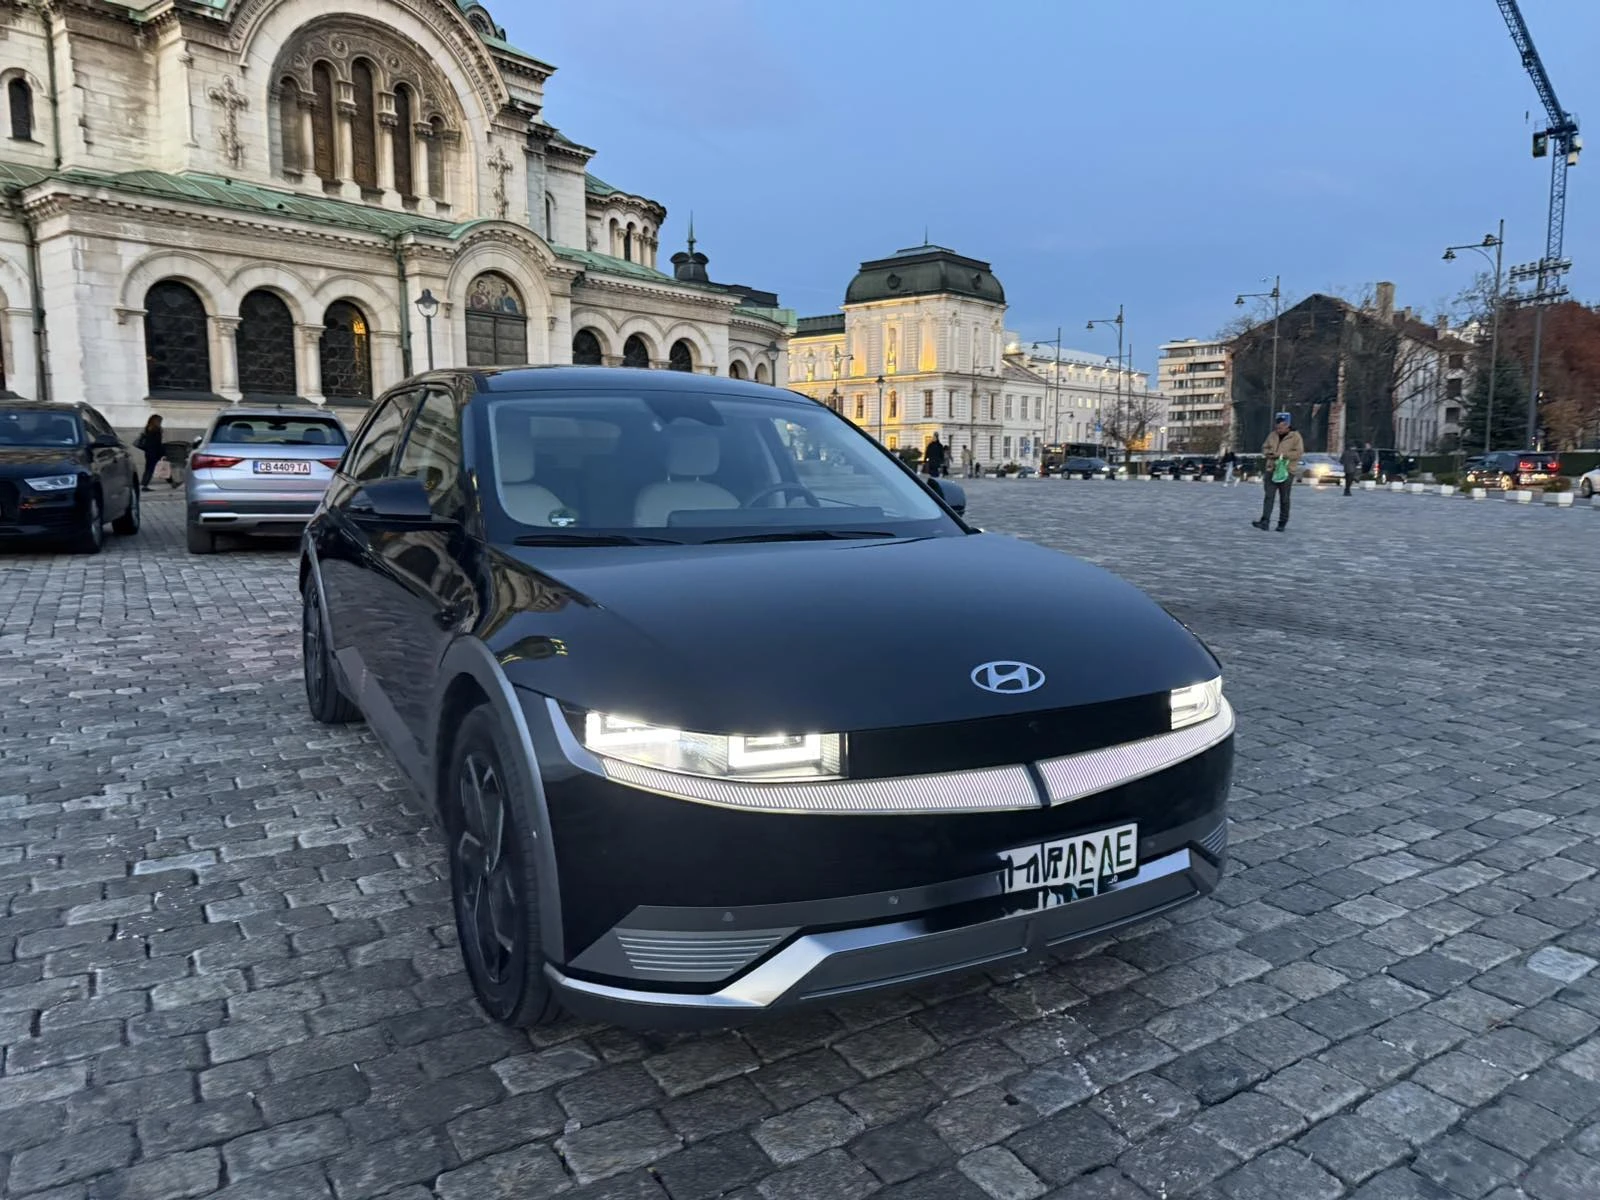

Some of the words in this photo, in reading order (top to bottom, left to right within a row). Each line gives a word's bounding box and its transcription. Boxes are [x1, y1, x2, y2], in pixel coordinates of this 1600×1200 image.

[260, 462, 272, 471] CB
[273, 463, 295, 471] 4409
[296, 463, 308, 472] TA
